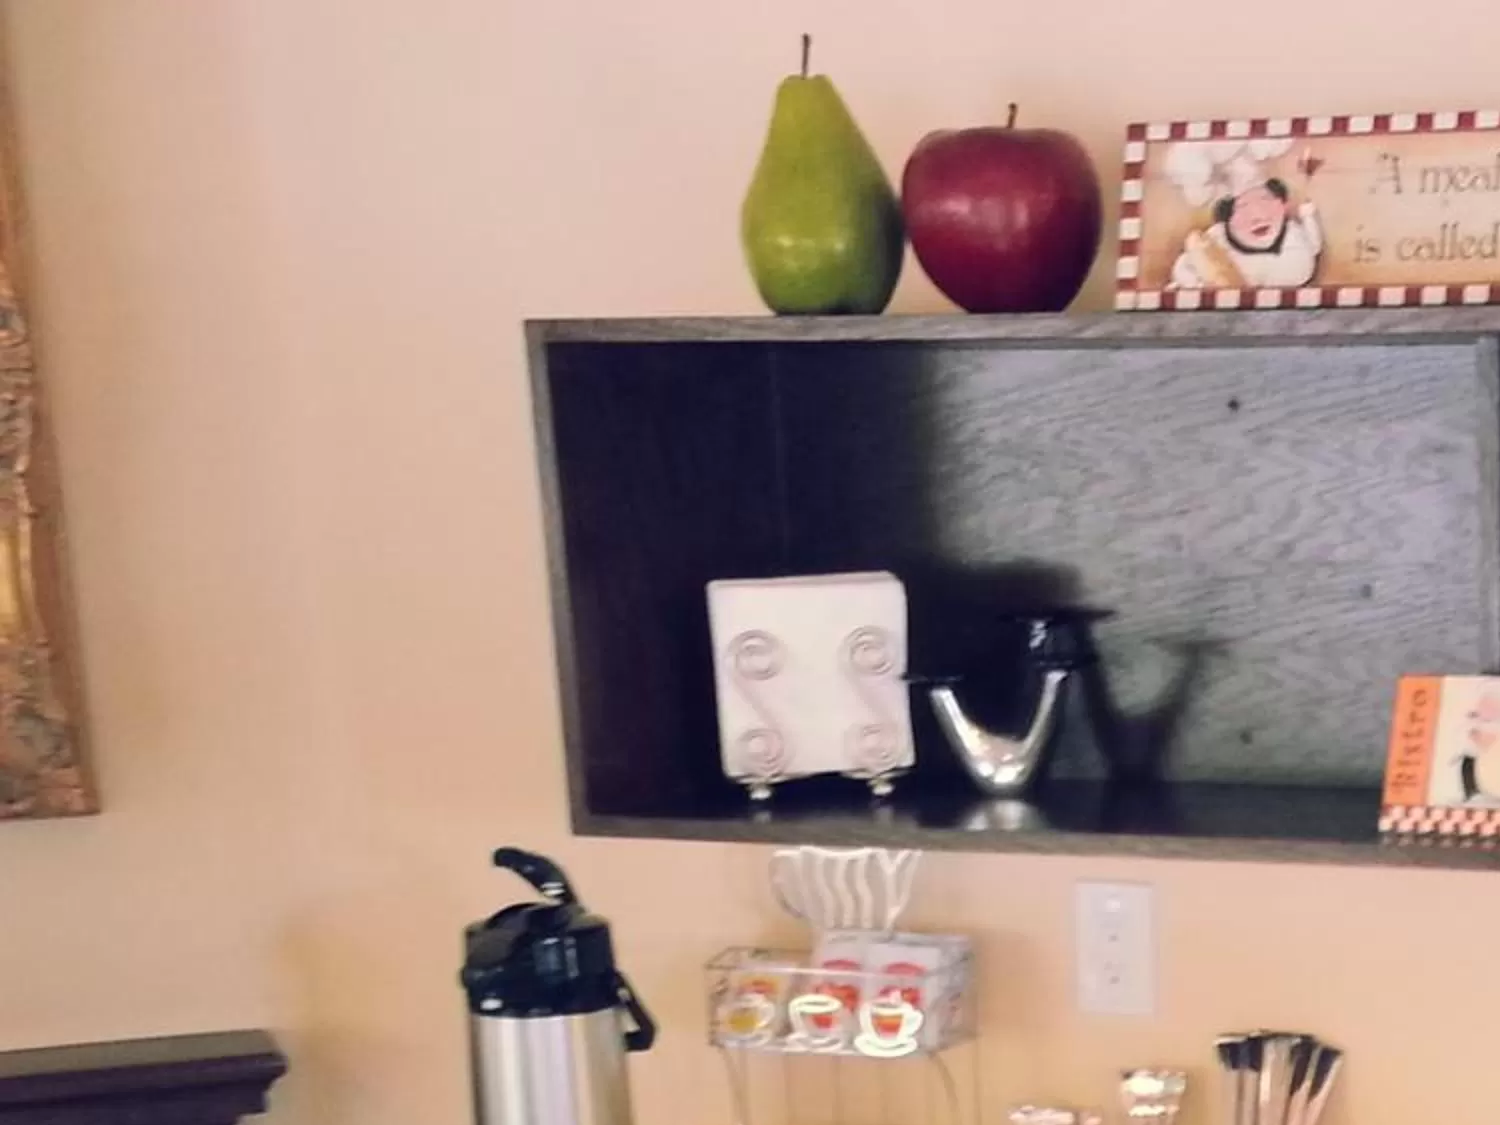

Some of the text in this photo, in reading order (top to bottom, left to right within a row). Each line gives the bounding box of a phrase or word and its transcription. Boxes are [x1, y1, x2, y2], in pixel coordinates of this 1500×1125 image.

[1369, 152, 1403, 194] A
[1353, 223, 1381, 263] is
[1396, 220, 1500, 261] called
